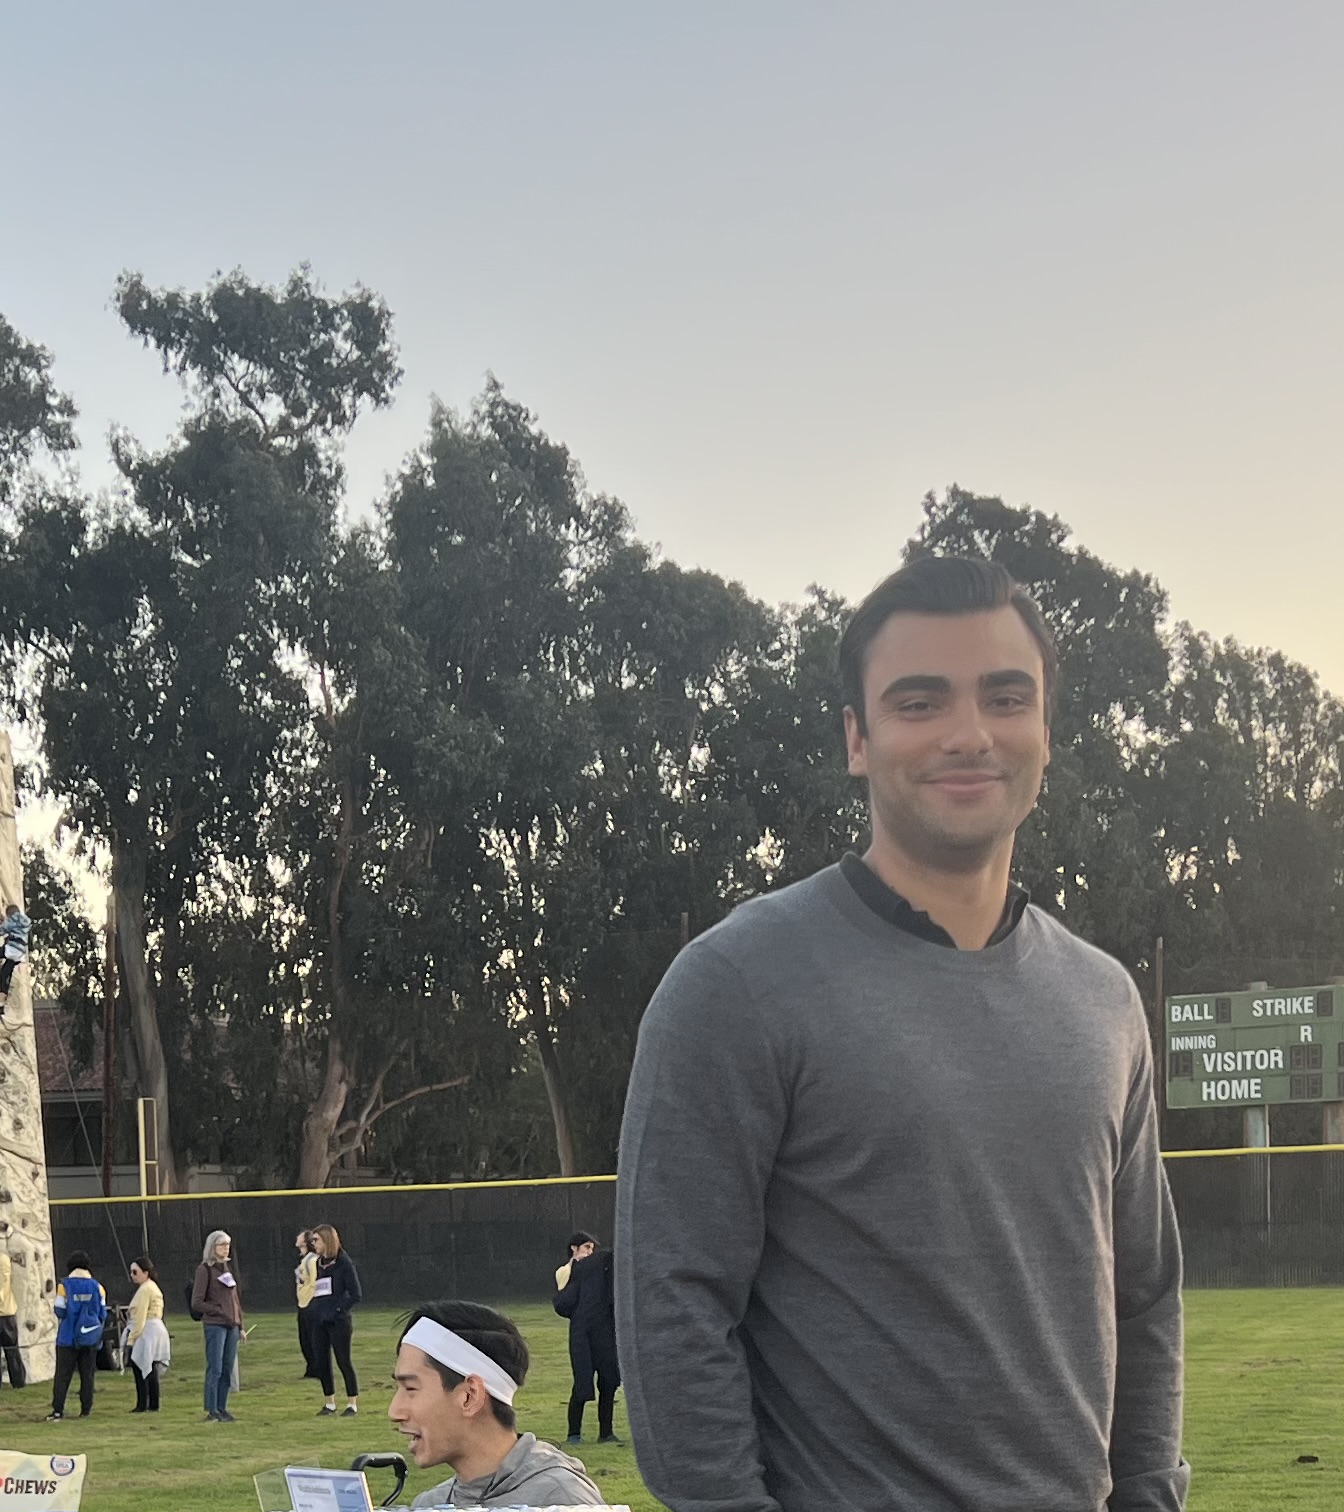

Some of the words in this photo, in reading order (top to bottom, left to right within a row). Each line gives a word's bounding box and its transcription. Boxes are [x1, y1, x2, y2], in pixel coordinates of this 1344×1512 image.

[1171, 1004, 1213, 1022] BALL
[1252, 996, 1314, 1018] STRIKE
[1171, 1034, 1216, 1050] INNING
[1300, 1025, 1312, 1042] R
[1202, 1049, 1284, 1073] VISITOR
[1201, 1078, 1262, 1101] HOME
